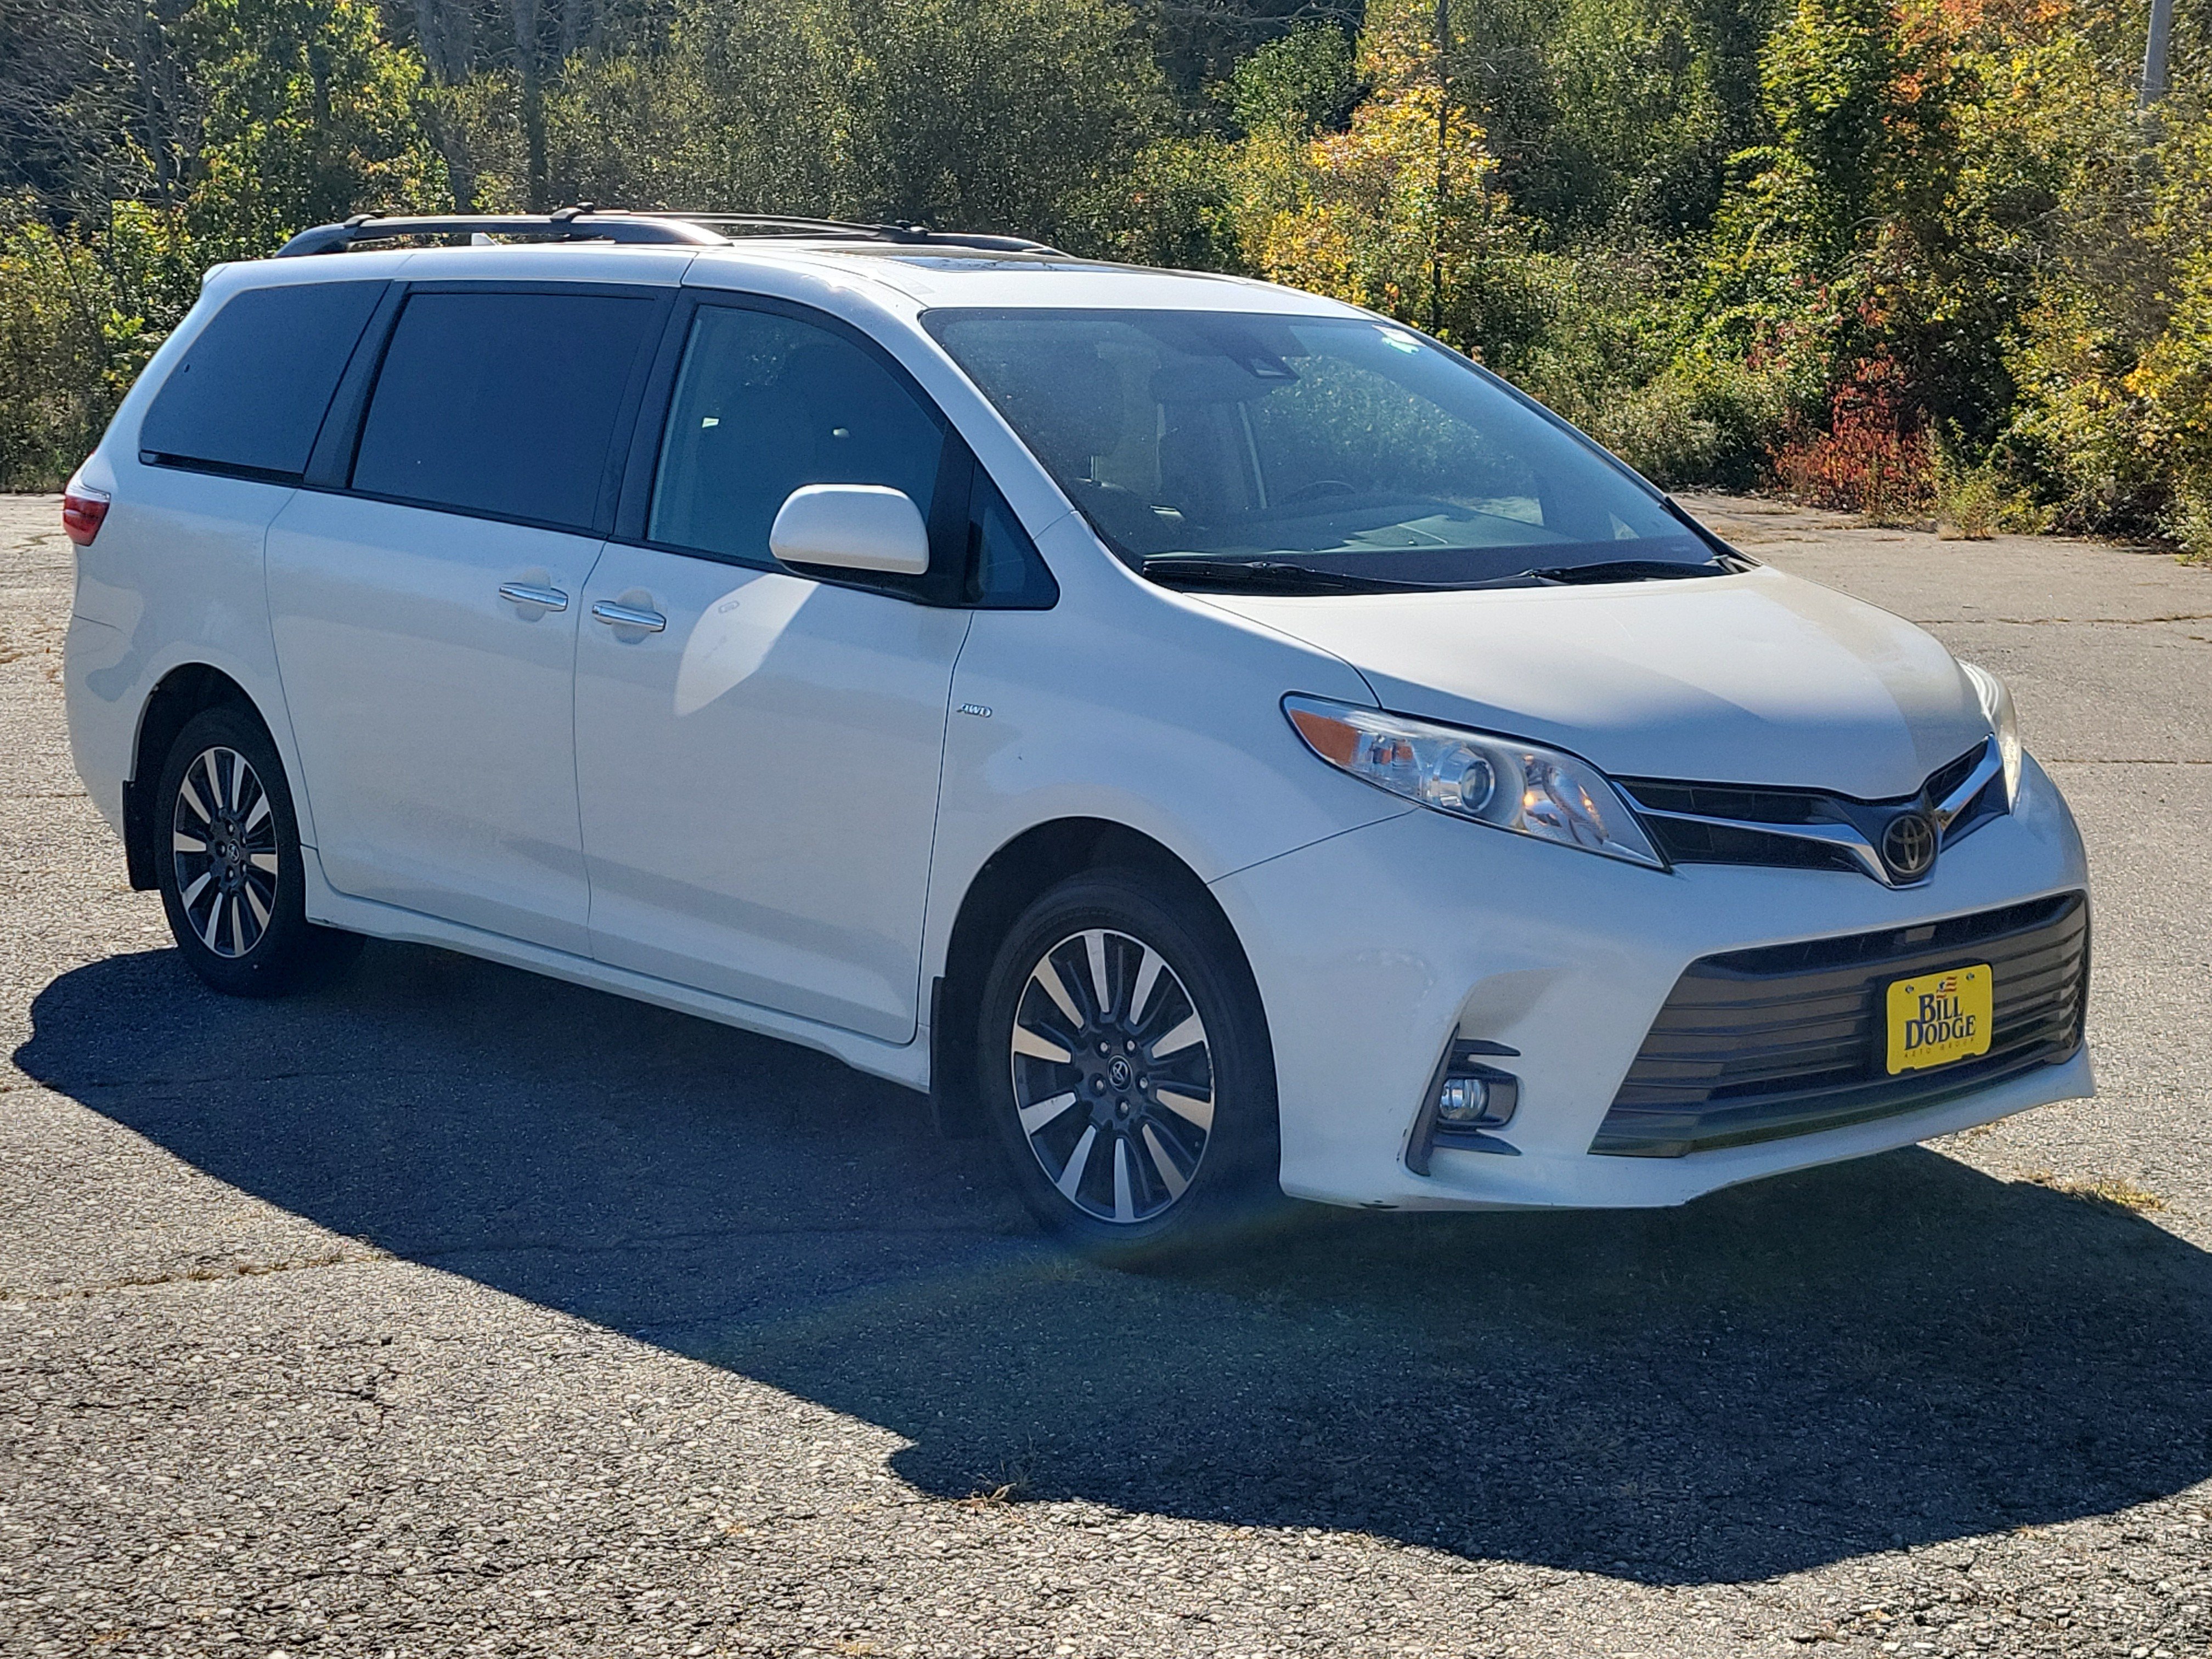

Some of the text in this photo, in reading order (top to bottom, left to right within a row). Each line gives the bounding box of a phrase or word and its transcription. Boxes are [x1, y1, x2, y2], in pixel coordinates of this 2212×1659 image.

[956, 703, 992, 718] AWD
[1918, 994, 1963, 1024] BILL
[1905, 1015, 1976, 1051] DODGE
